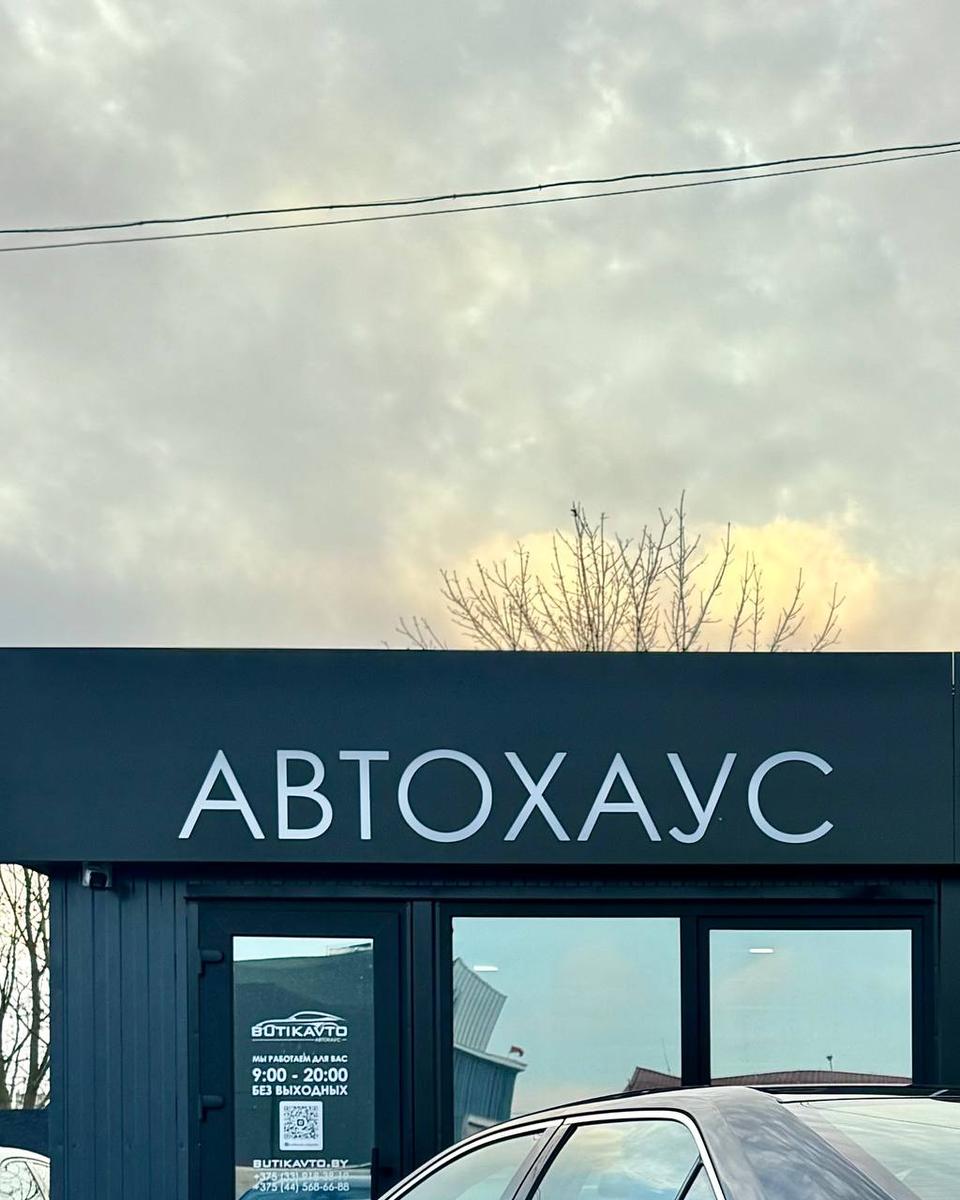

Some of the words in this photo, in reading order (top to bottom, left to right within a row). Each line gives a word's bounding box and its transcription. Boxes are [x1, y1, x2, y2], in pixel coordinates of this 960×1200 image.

[178, 749, 835, 845] АВТОХАУС
[251, 1025, 348, 1038] BUTIKAVTO
[252, 1055, 267, 1063] МЫ
[268, 1055, 311, 1063] РАБОТАЕМ
[312, 1055, 329, 1064] ДЛЯ
[330, 1055, 348, 1063] ВАС
[252, 1067, 287, 1083] 9:00
[303, 1067, 348, 1083] 20:00
[252, 1085, 272, 1096] БЕЗ
[275, 1085, 348, 1097] ВЫХОДНЫХ
[253, 1159, 349, 1168] BUTIKAVTO.BY
[254, 1172, 277, 1182] +375
[280, 1171, 299, 1183] (33)
[253, 1182, 278, 1191] +375
[280, 1182, 299, 1193] (44)
[302, 1182, 350, 1191] 568-66-88
